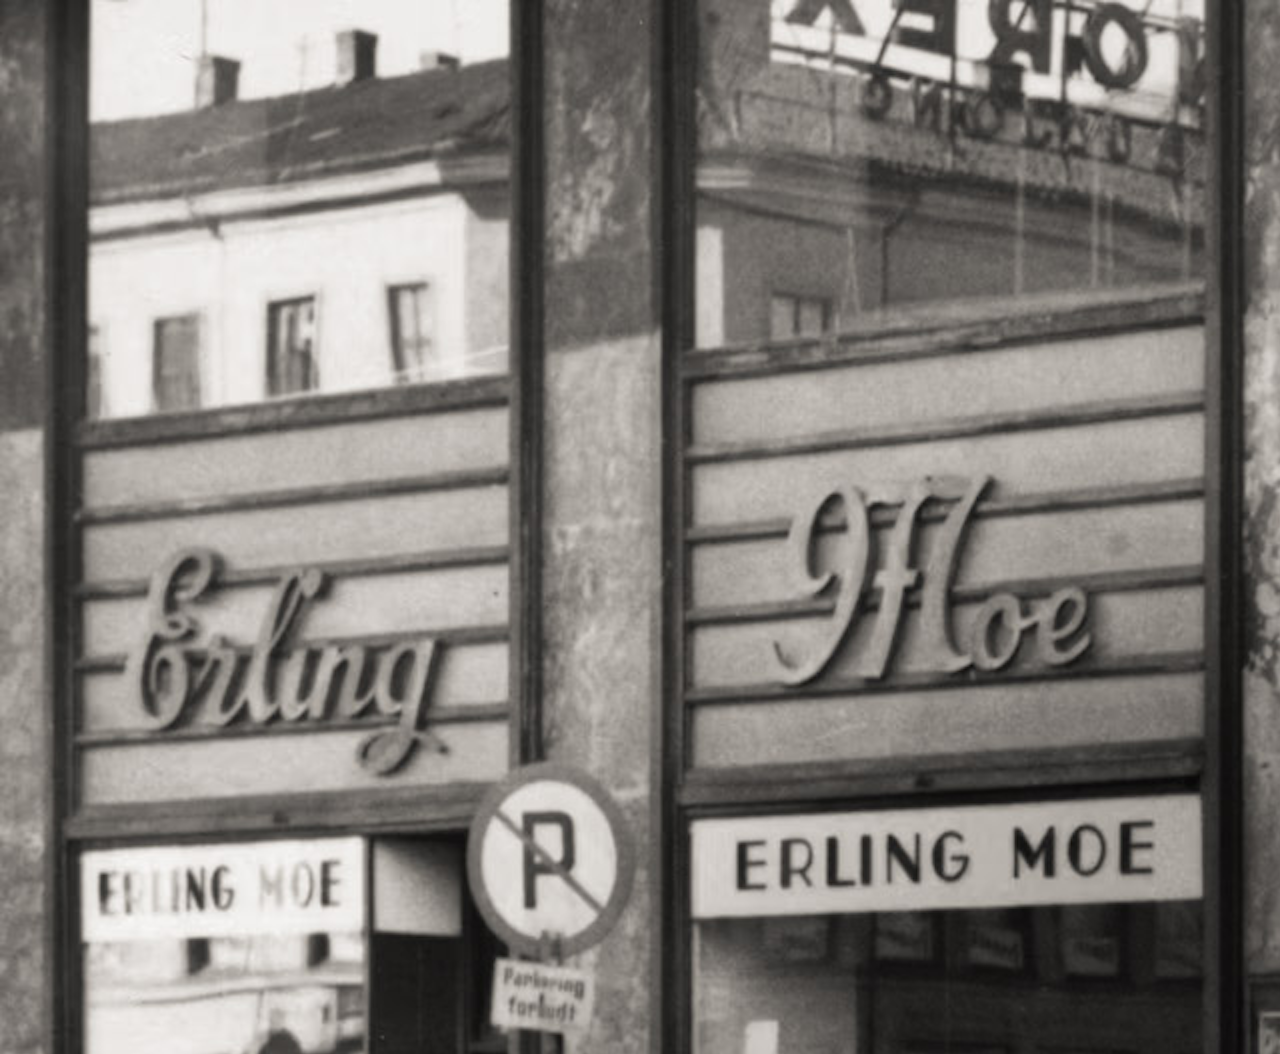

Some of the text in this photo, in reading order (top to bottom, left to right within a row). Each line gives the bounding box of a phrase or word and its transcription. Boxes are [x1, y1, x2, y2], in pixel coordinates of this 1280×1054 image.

[772, 475, 1095, 685] Moe
[125, 550, 451, 776] Erling
[98, 857, 343, 918] ERLING MOE
[522, 810, 576, 910] P
[735, 820, 1156, 891] ERLING MOE
